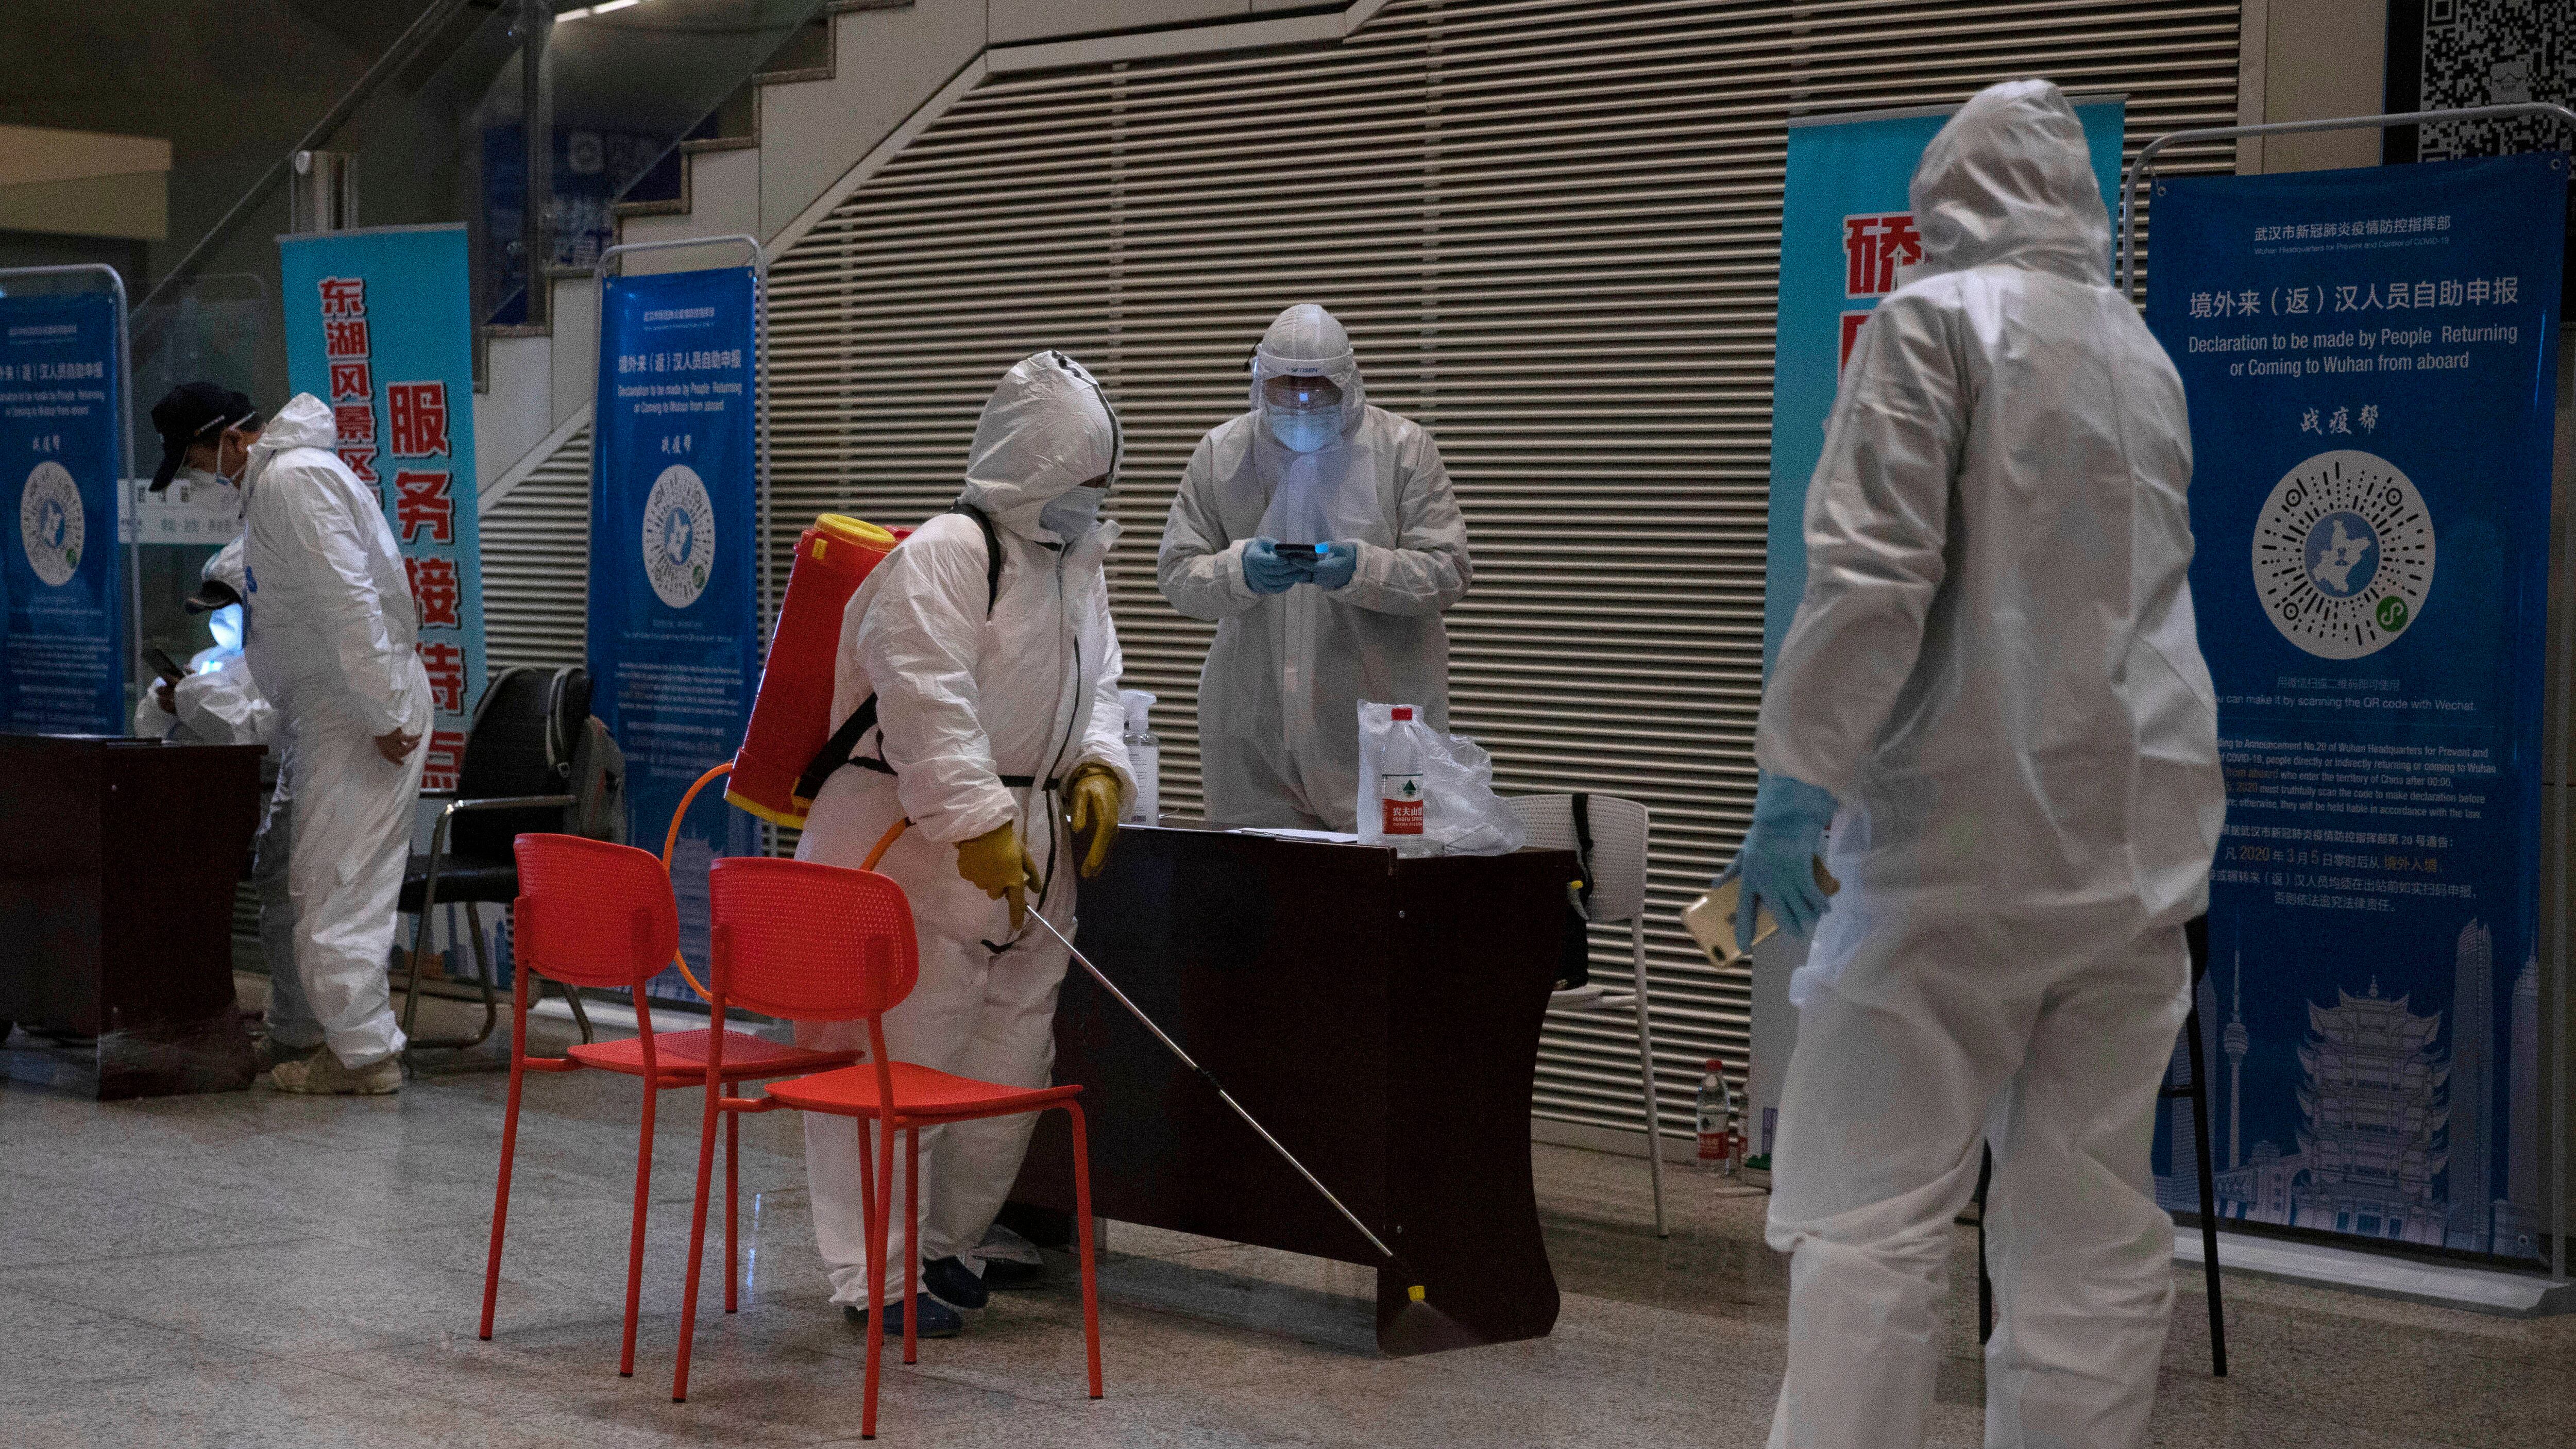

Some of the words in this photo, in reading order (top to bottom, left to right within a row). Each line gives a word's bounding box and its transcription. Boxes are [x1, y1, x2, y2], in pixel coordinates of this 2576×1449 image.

[2255, 215, 2451, 241] 武汉市新冠肺炎疫情防控指挥部
[2190, 277, 2517, 318] 境外来（返）汉人员自助申报
[2189, 335, 2267, 352] Declaration
[2272, 334, 2286, 349] to
[2291, 333, 2308, 349] be
[2313, 331, 2354, 348] made
[2359, 330, 2376, 349] by
[2381, 327, 2431, 348] People
[2442, 324, 2517, 344] Returning
[2230, 363, 2244, 376] or
[2248, 359, 2301, 378] Coming
[2306, 358, 2319, 373] to
[2324, 356, 2372, 373] Wuhan
[2378, 354, 2412, 370] from
[2417, 351, 2469, 369] aboard
[318, 278, 382, 508] 东湖风景区
[387, 382, 463, 790] 服务接待点
[2246, 695, 2272, 704] make
[2283, 696, 2294, 707] by
[2298, 698, 2342, 709] scanning
[2345, 698, 2360, 707] the
[2363, 697, 2379, 707] QR
[2382, 700, 2408, 709] code
[2411, 700, 2432, 709] with
